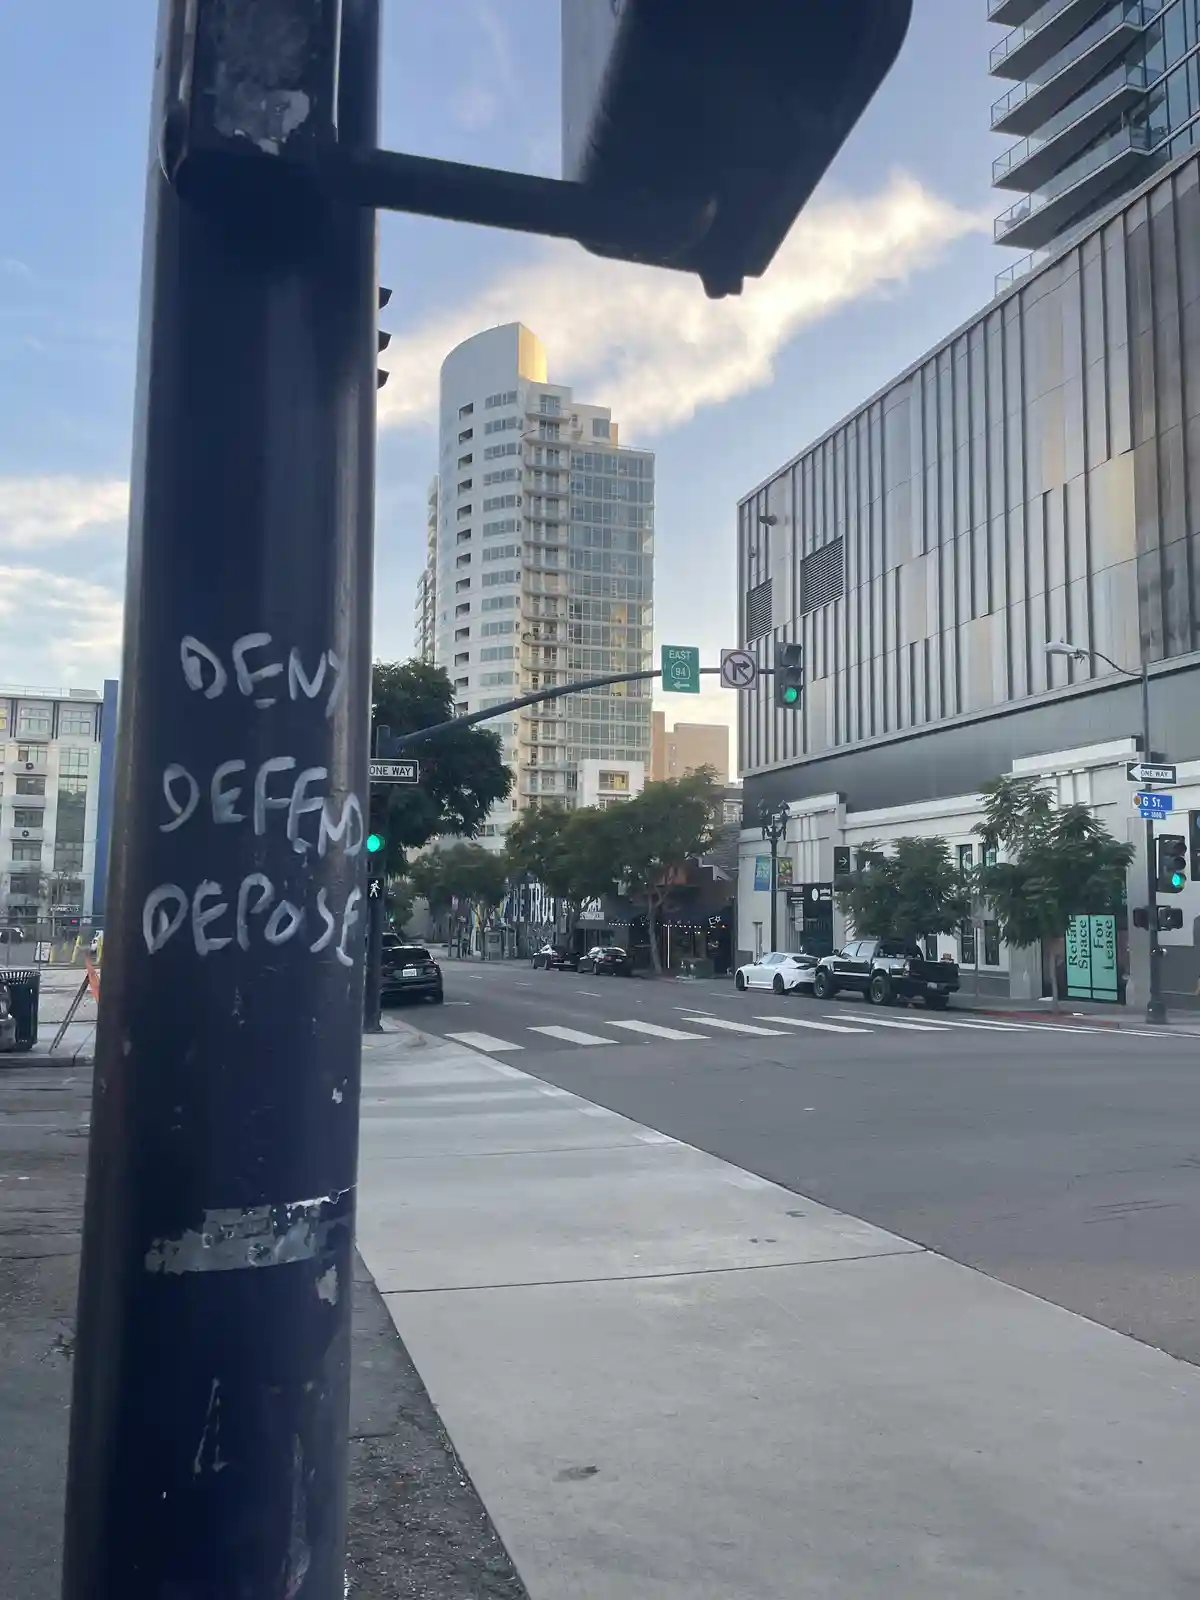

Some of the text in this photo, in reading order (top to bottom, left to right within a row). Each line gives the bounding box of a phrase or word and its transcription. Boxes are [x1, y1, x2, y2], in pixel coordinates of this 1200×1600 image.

[670, 650, 692, 660] EAST
[180, 632, 344, 718] DENY
[676, 667, 686, 676] 94
[370, 766, 412, 776] ONE WAY
[1141, 769, 1153, 777] ONE
[1143, 796, 1149, 807] G
[512, 883, 525, 923] BE
[142, 872, 362, 967] DEPOSE
[1093, 919, 1104, 949] For
[1078, 919, 1092, 969] Space
[1103, 919, 1114, 970] Lease
